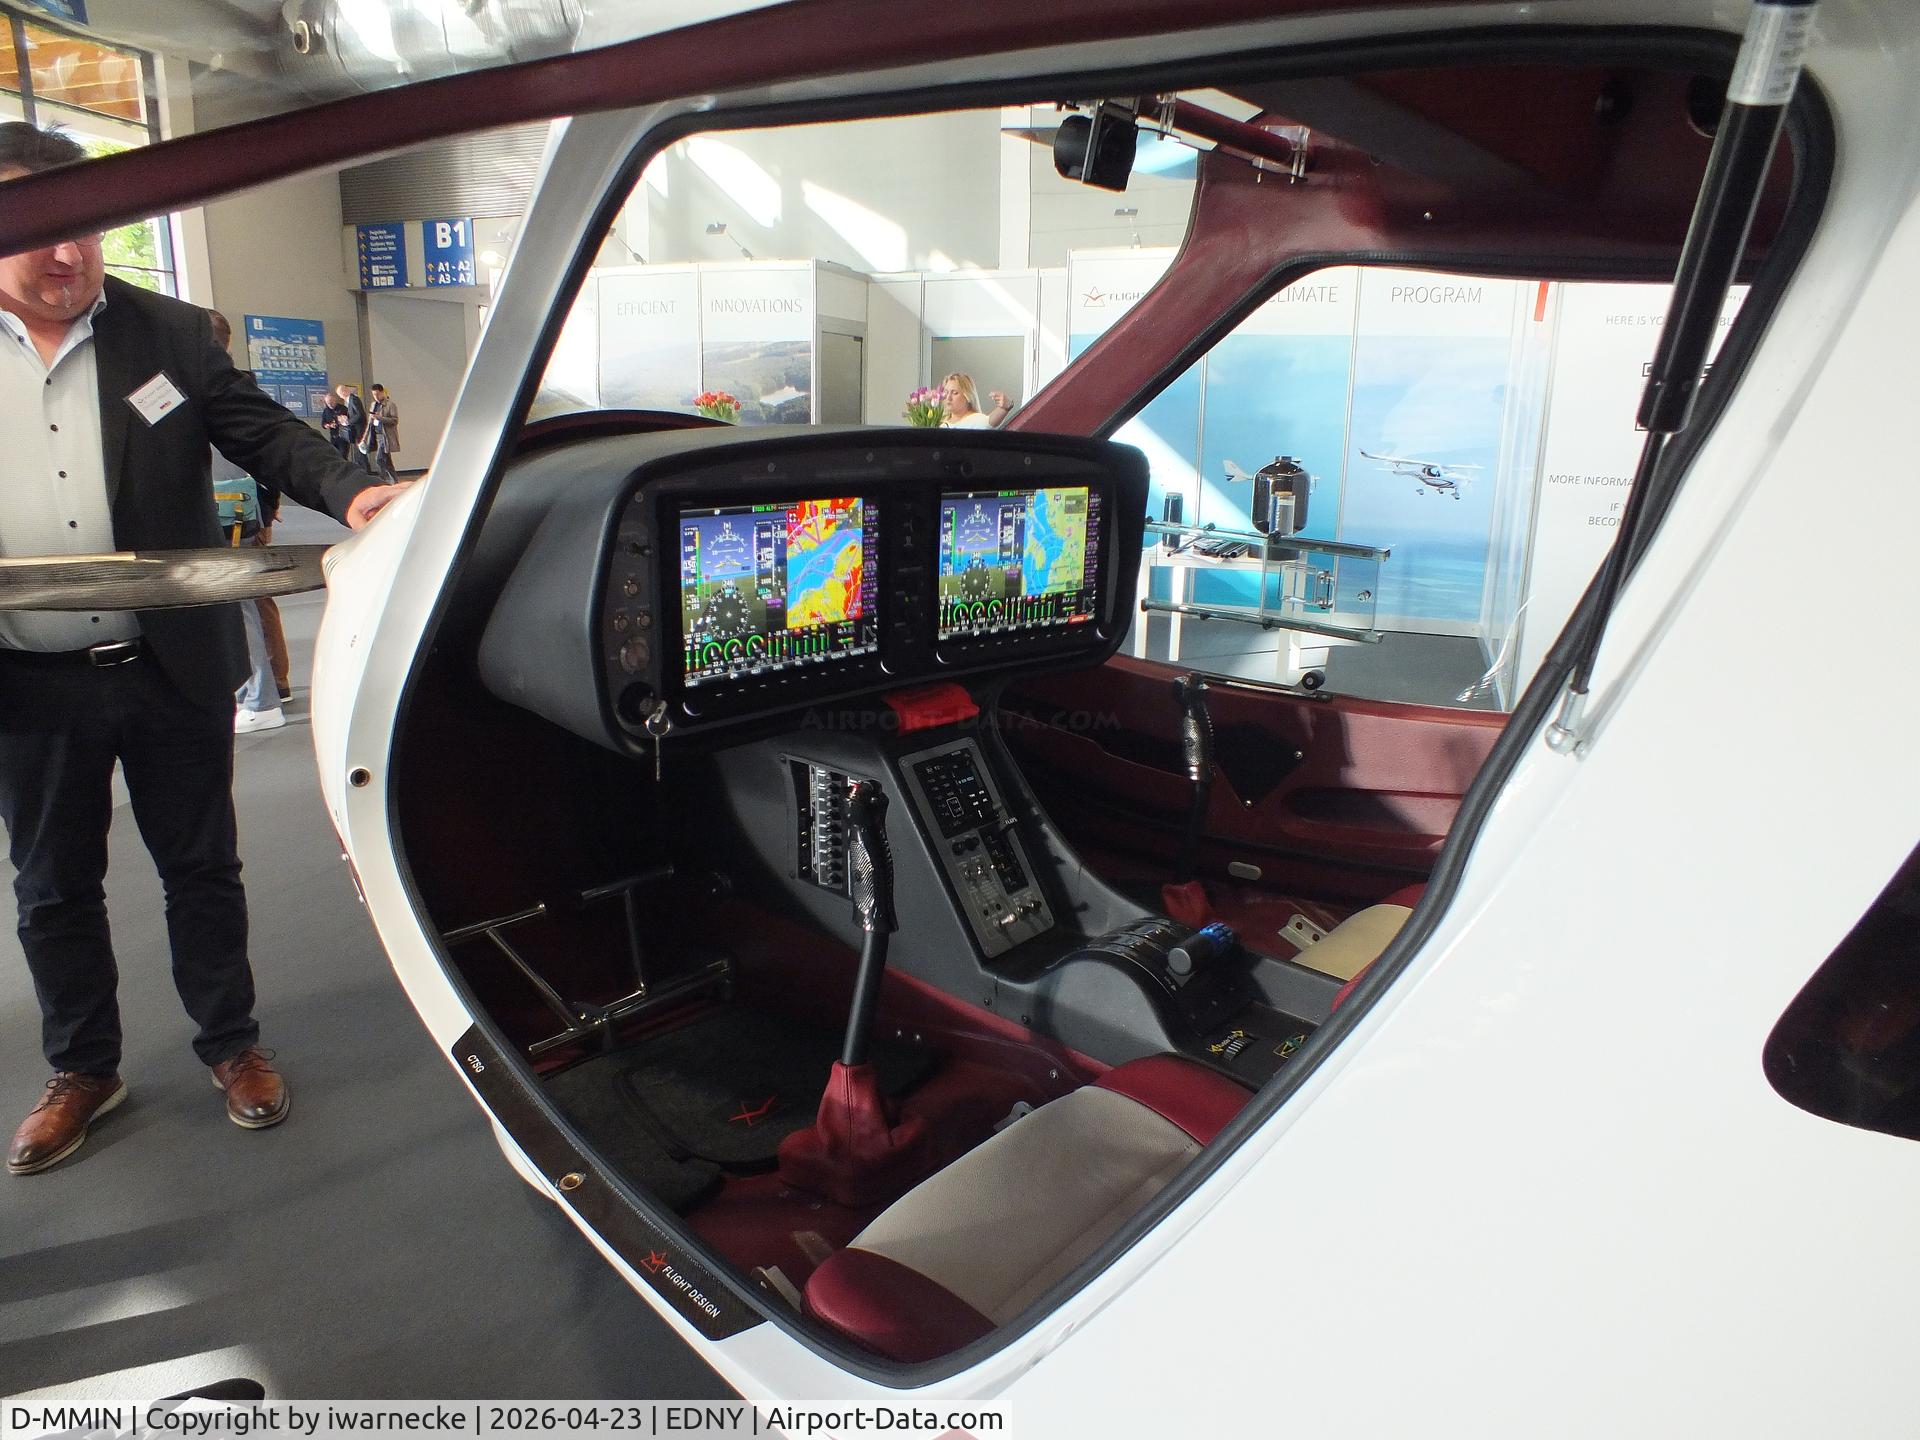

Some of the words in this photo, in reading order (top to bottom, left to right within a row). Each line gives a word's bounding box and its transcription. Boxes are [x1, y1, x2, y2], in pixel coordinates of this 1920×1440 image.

[435, 221, 466, 249] B1
[437, 261, 450, 273] A1
[458, 260, 471, 272] A2
[438, 274, 451, 284] A3
[458, 273, 472, 283] A7
[1109, 291, 1145, 301] FLIGH
[1268, 286, 1338, 303] LIMATE
[1391, 286, 1482, 304] PROGRAM
[616, 299, 676, 317] EFFICIENT
[710, 297, 803, 314] INNOVATIONS
[1606, 315, 1633, 326] HERE
[1636, 315, 1646, 326] IS
[1548, 474, 1581, 485] MORE
[1583, 476, 1634, 487] INFORMA
[1610, 502, 1619, 512] IF
[467, 1053, 485, 1074] CTSG
[662, 1265, 693, 1292] FLIGHT
[687, 1288, 721, 1318] DESIGN
